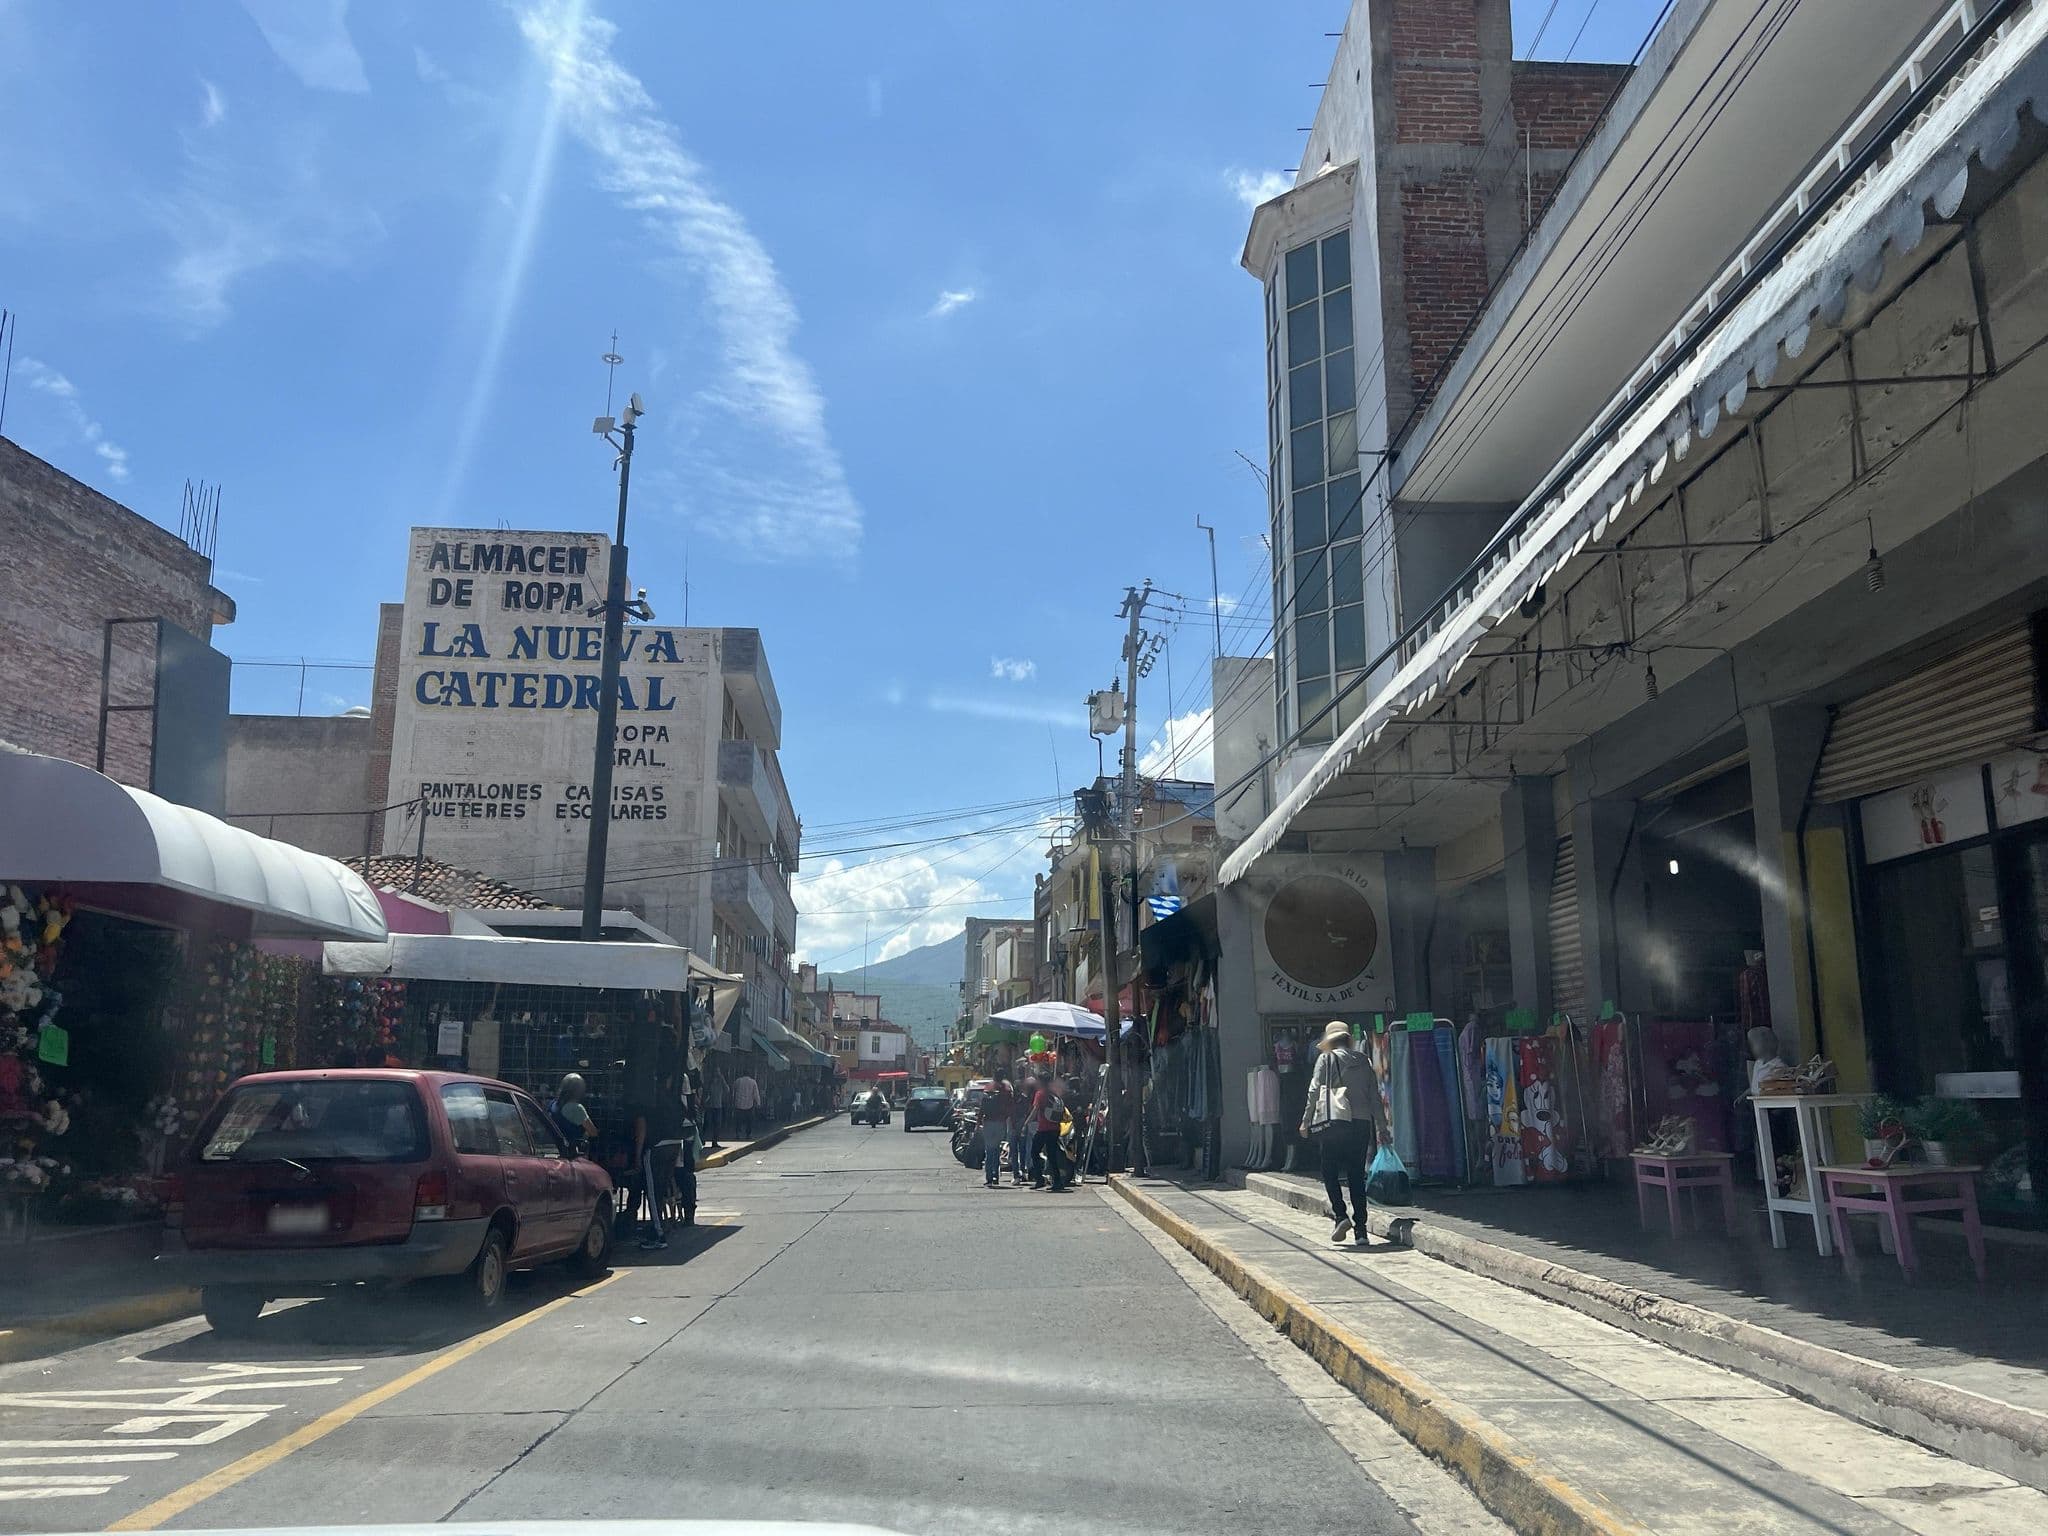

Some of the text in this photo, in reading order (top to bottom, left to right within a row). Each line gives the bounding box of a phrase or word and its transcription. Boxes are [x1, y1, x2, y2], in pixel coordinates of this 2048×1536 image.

[427, 542, 588, 575] ALMACEN
[429, 577, 584, 611] DE ROPA
[419, 622, 684, 663] LA NUEVA
[415, 670, 677, 712] CATEDRAL
[612, 748, 665, 767] RAL.
[421, 783, 542, 800] PANTALONES
[565, 785, 664, 801] CAISAS
[556, 803, 667, 820] ESCLARES
